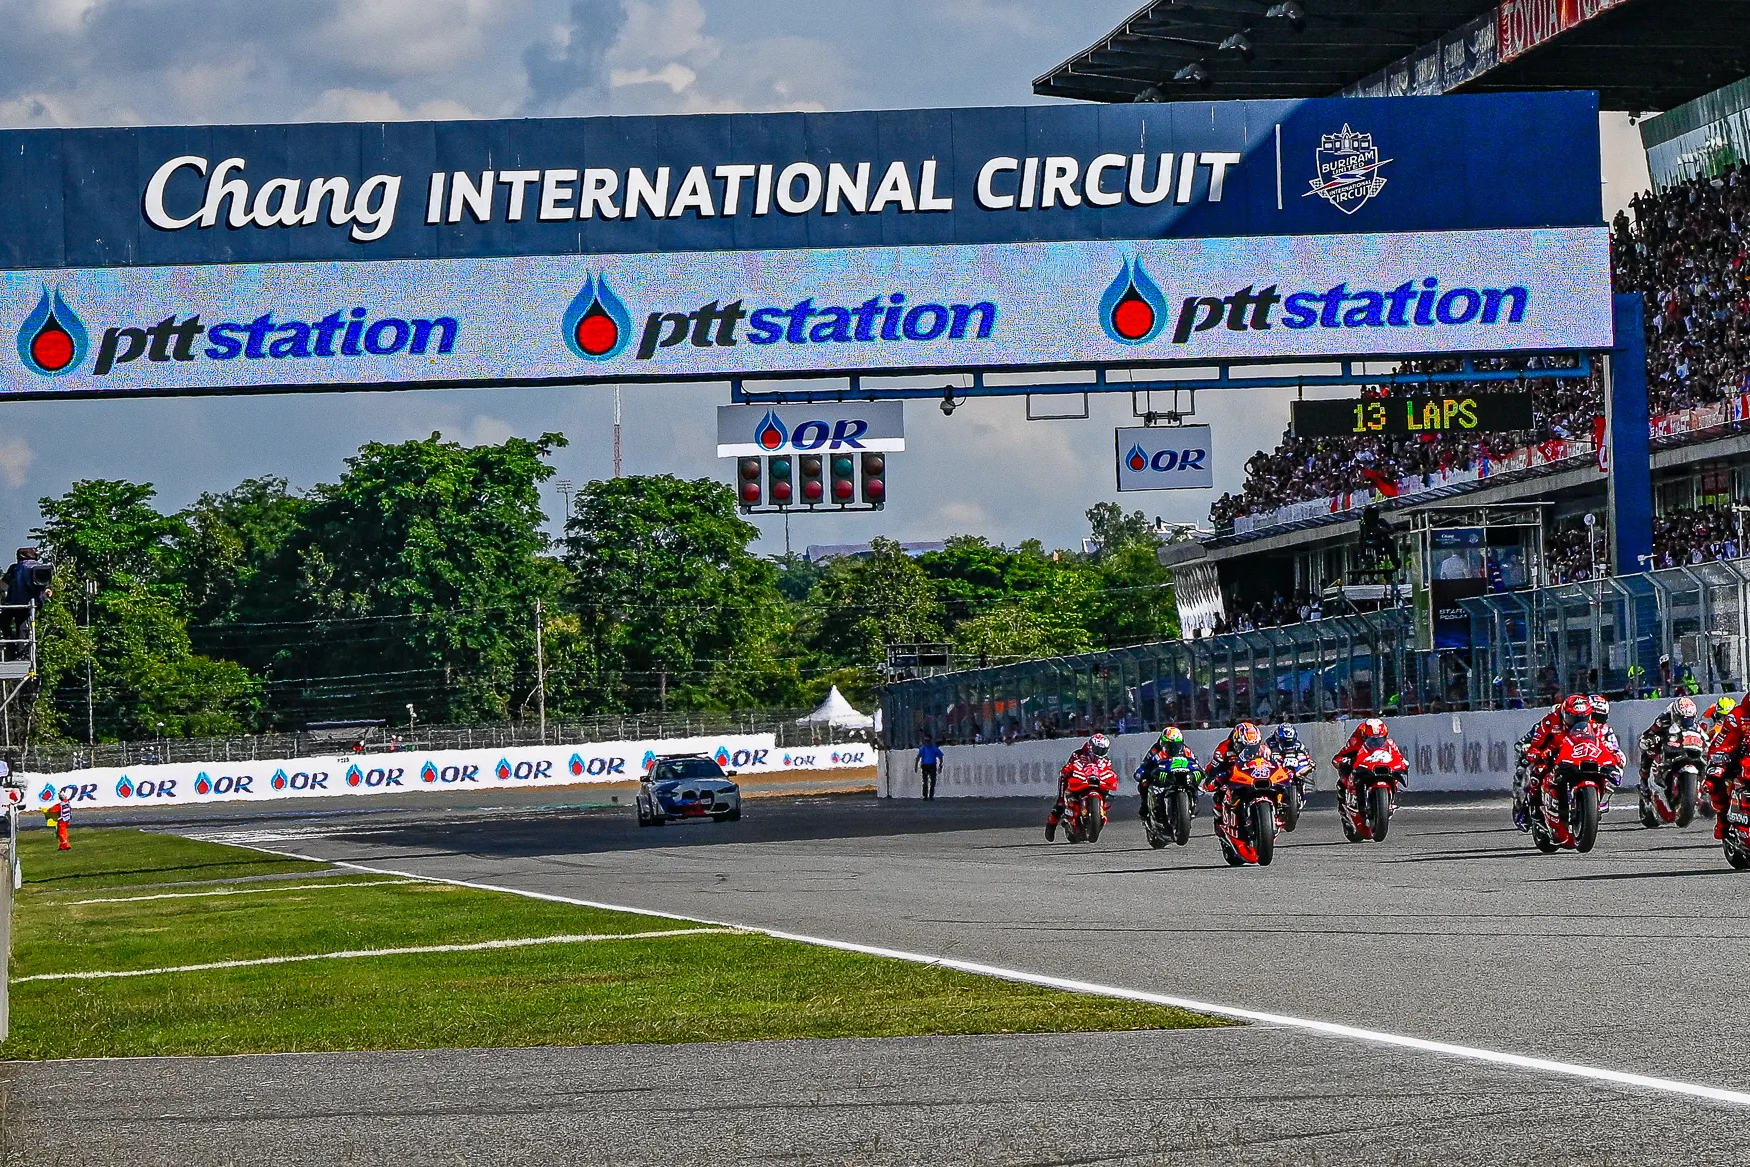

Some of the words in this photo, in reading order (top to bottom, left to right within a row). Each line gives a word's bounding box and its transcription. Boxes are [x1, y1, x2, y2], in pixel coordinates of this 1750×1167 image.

[1323, 151, 1374, 173] BURIRAM
[1333, 163, 1364, 175] UNITED
[145, 155, 401, 241] Chang
[427, 158, 952, 224] INTERNATIONAL
[977, 152, 1241, 210] CIRCUIT
[1330, 180, 1371, 195] INTERNATIONAL
[1331, 186, 1370, 203] CIRCUIT
[1353, 402, 1386, 433] 13
[1407, 399, 1478, 432] LAPS
[791, 420, 868, 451] OR
[1150, 446, 1206, 474] OR
[731, 748, 769, 768] OR
[841, 751, 864, 764] OR
[1571, 742, 1602, 758] 37
[514, 760, 552, 780] OR
[586, 756, 625, 776] OR
[793, 755, 816, 767] OR
[1171, 758, 1188, 769] 21
[290, 771, 329, 791] OR
[365, 767, 404, 787] OR
[440, 764, 479, 783] OR
[60, 783, 98, 801] OR
[136, 779, 177, 798] OR
[213, 775, 254, 794] OR
